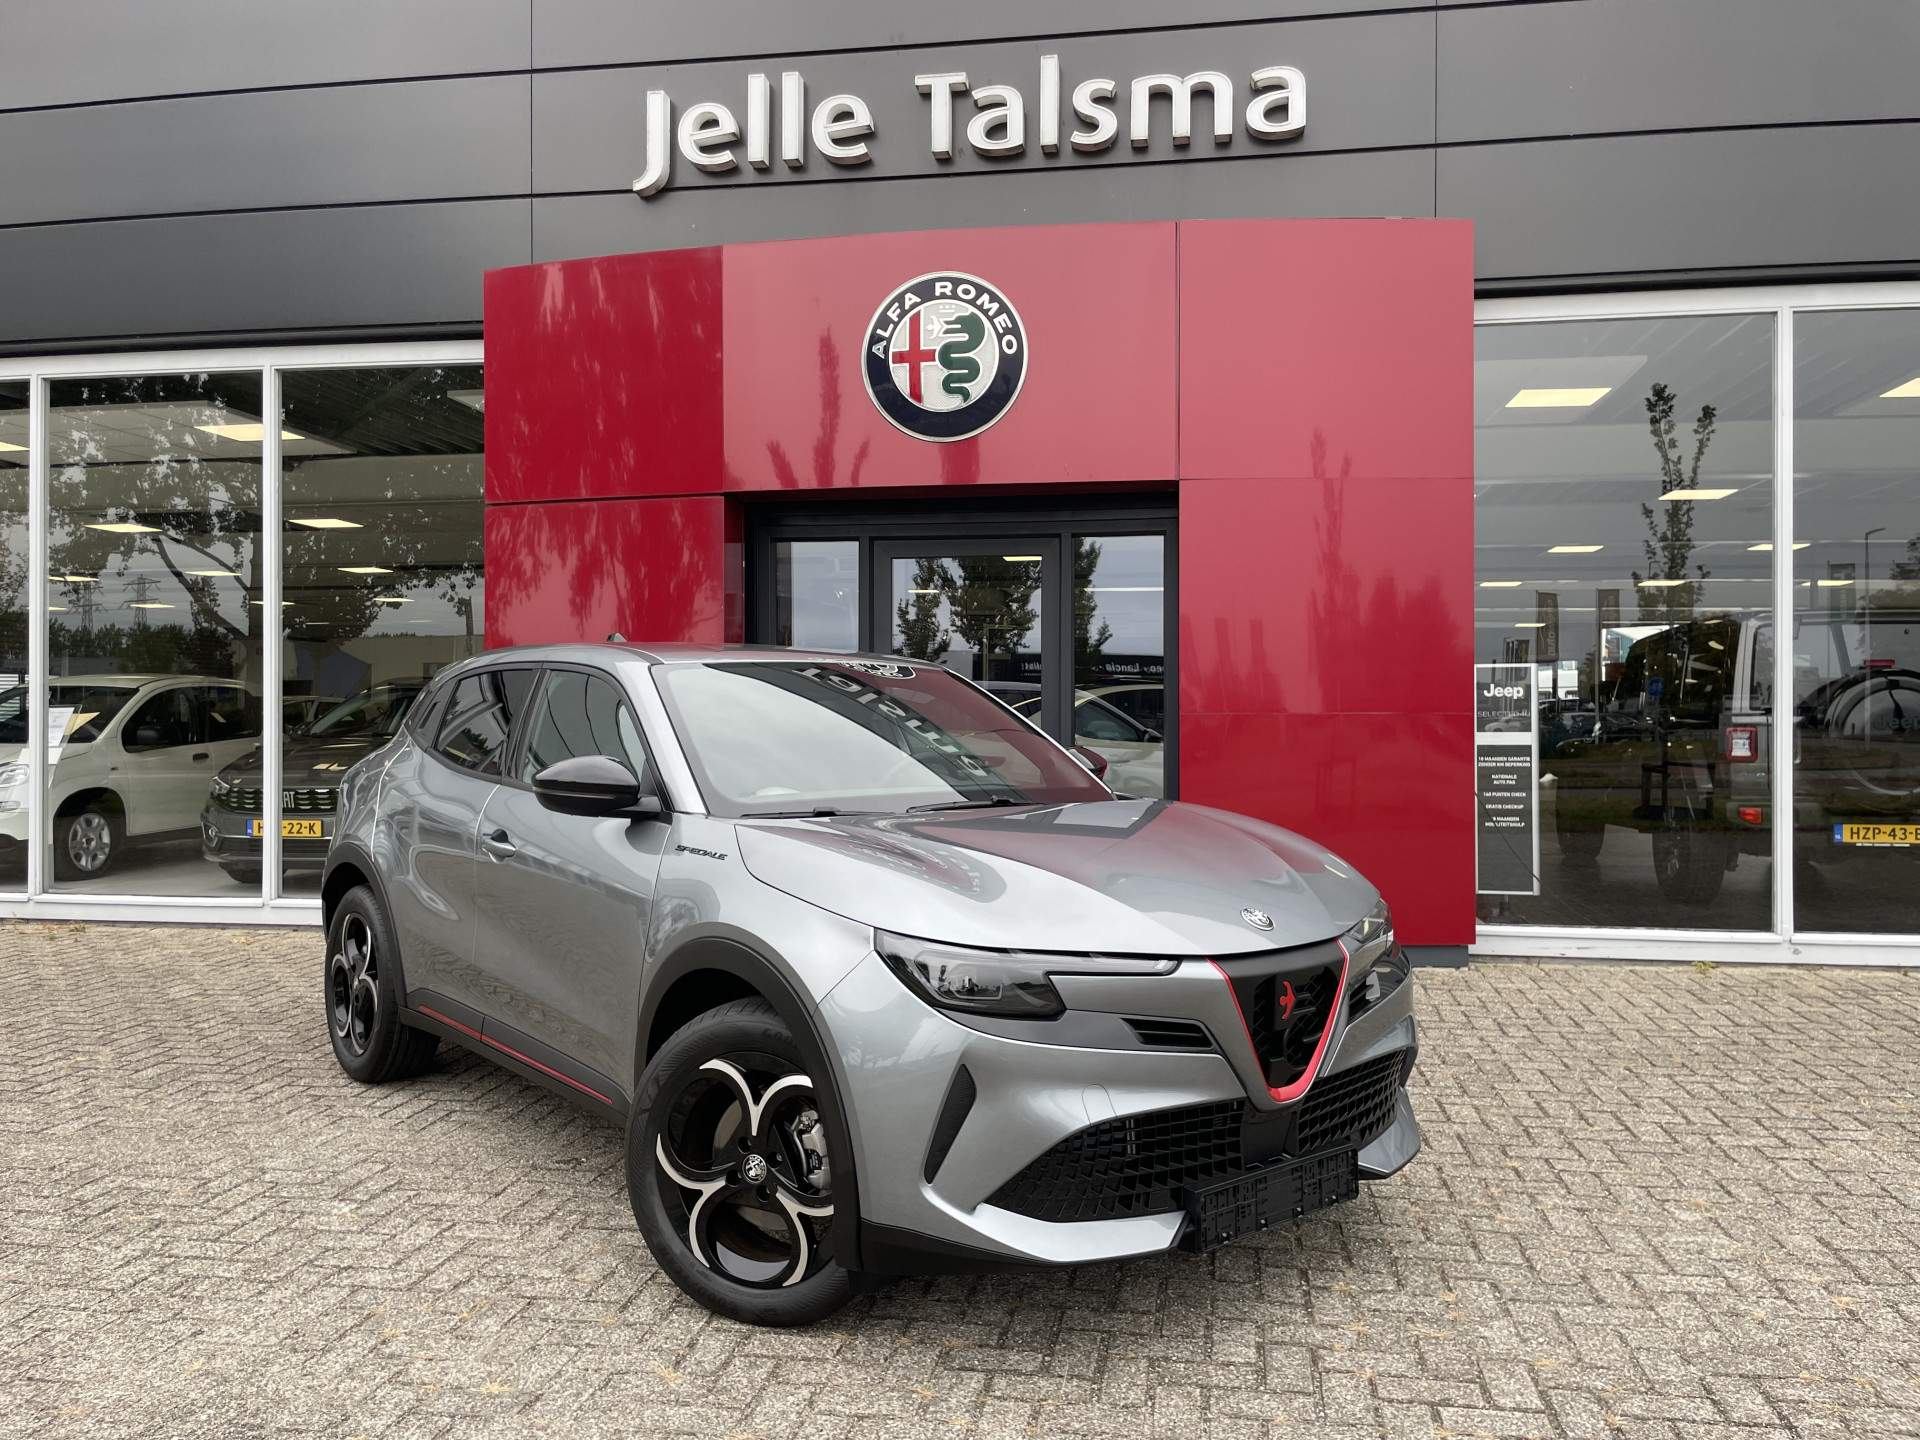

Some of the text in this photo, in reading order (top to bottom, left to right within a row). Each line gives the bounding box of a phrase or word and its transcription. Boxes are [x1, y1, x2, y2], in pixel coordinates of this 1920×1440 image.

[632, 54, 1306, 198] Jelle Talsma
[871, 281, 1018, 360] ALFA ROMEO
[1483, 683, 1524, 700] Jeep
[282, 791, 295, 808] AT
[257, 822, 316, 835] H-22-K
[675, 844, 728, 860] SPECIALE
